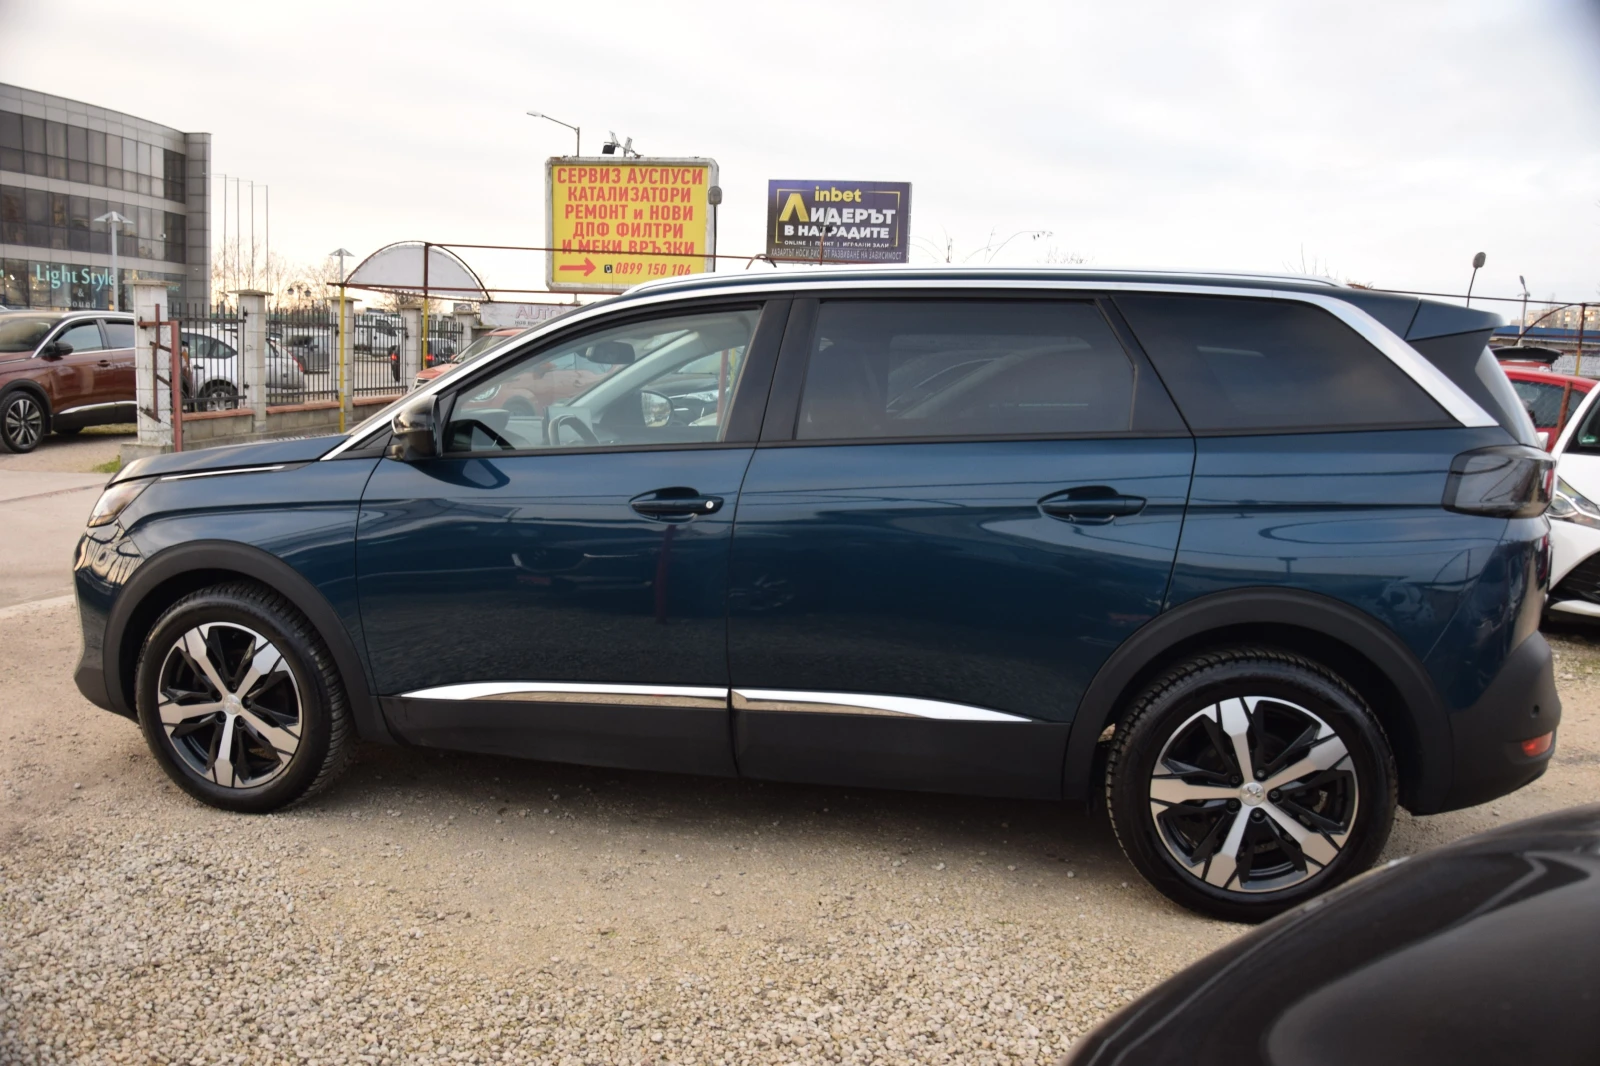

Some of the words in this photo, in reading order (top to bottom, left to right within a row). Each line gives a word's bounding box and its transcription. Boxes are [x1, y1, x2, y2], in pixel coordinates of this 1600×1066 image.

[557, 167, 621, 184] СЕРВИЗ
[626, 168, 704, 185] АУСПУСИ
[567, 186, 691, 203] КАТАЛИЗАТОРИ
[814, 186, 862, 203] inbet
[564, 204, 628, 220] РЕМОНТ
[649, 205, 693, 221] НОВИ
[573, 221, 610, 240] ДПФ
[616, 222, 684, 239] ФИЛТРИ
[784, 225, 794, 236] В
[798, 225, 889, 239] НАРАДИТЕ
[562, 239, 572, 254] И
[578, 239, 622, 255] МЕКИ
[628, 241, 695, 256] ВРЪЗКИ
[36, 264, 78, 289] Light
[81, 268, 115, 291] Style
[615, 262, 643, 275] 0899
[647, 263, 667, 275] 150
[671, 264, 691, 276] 106
[77, 288, 85, 298] &
[67, 299, 97, 308] Sound
